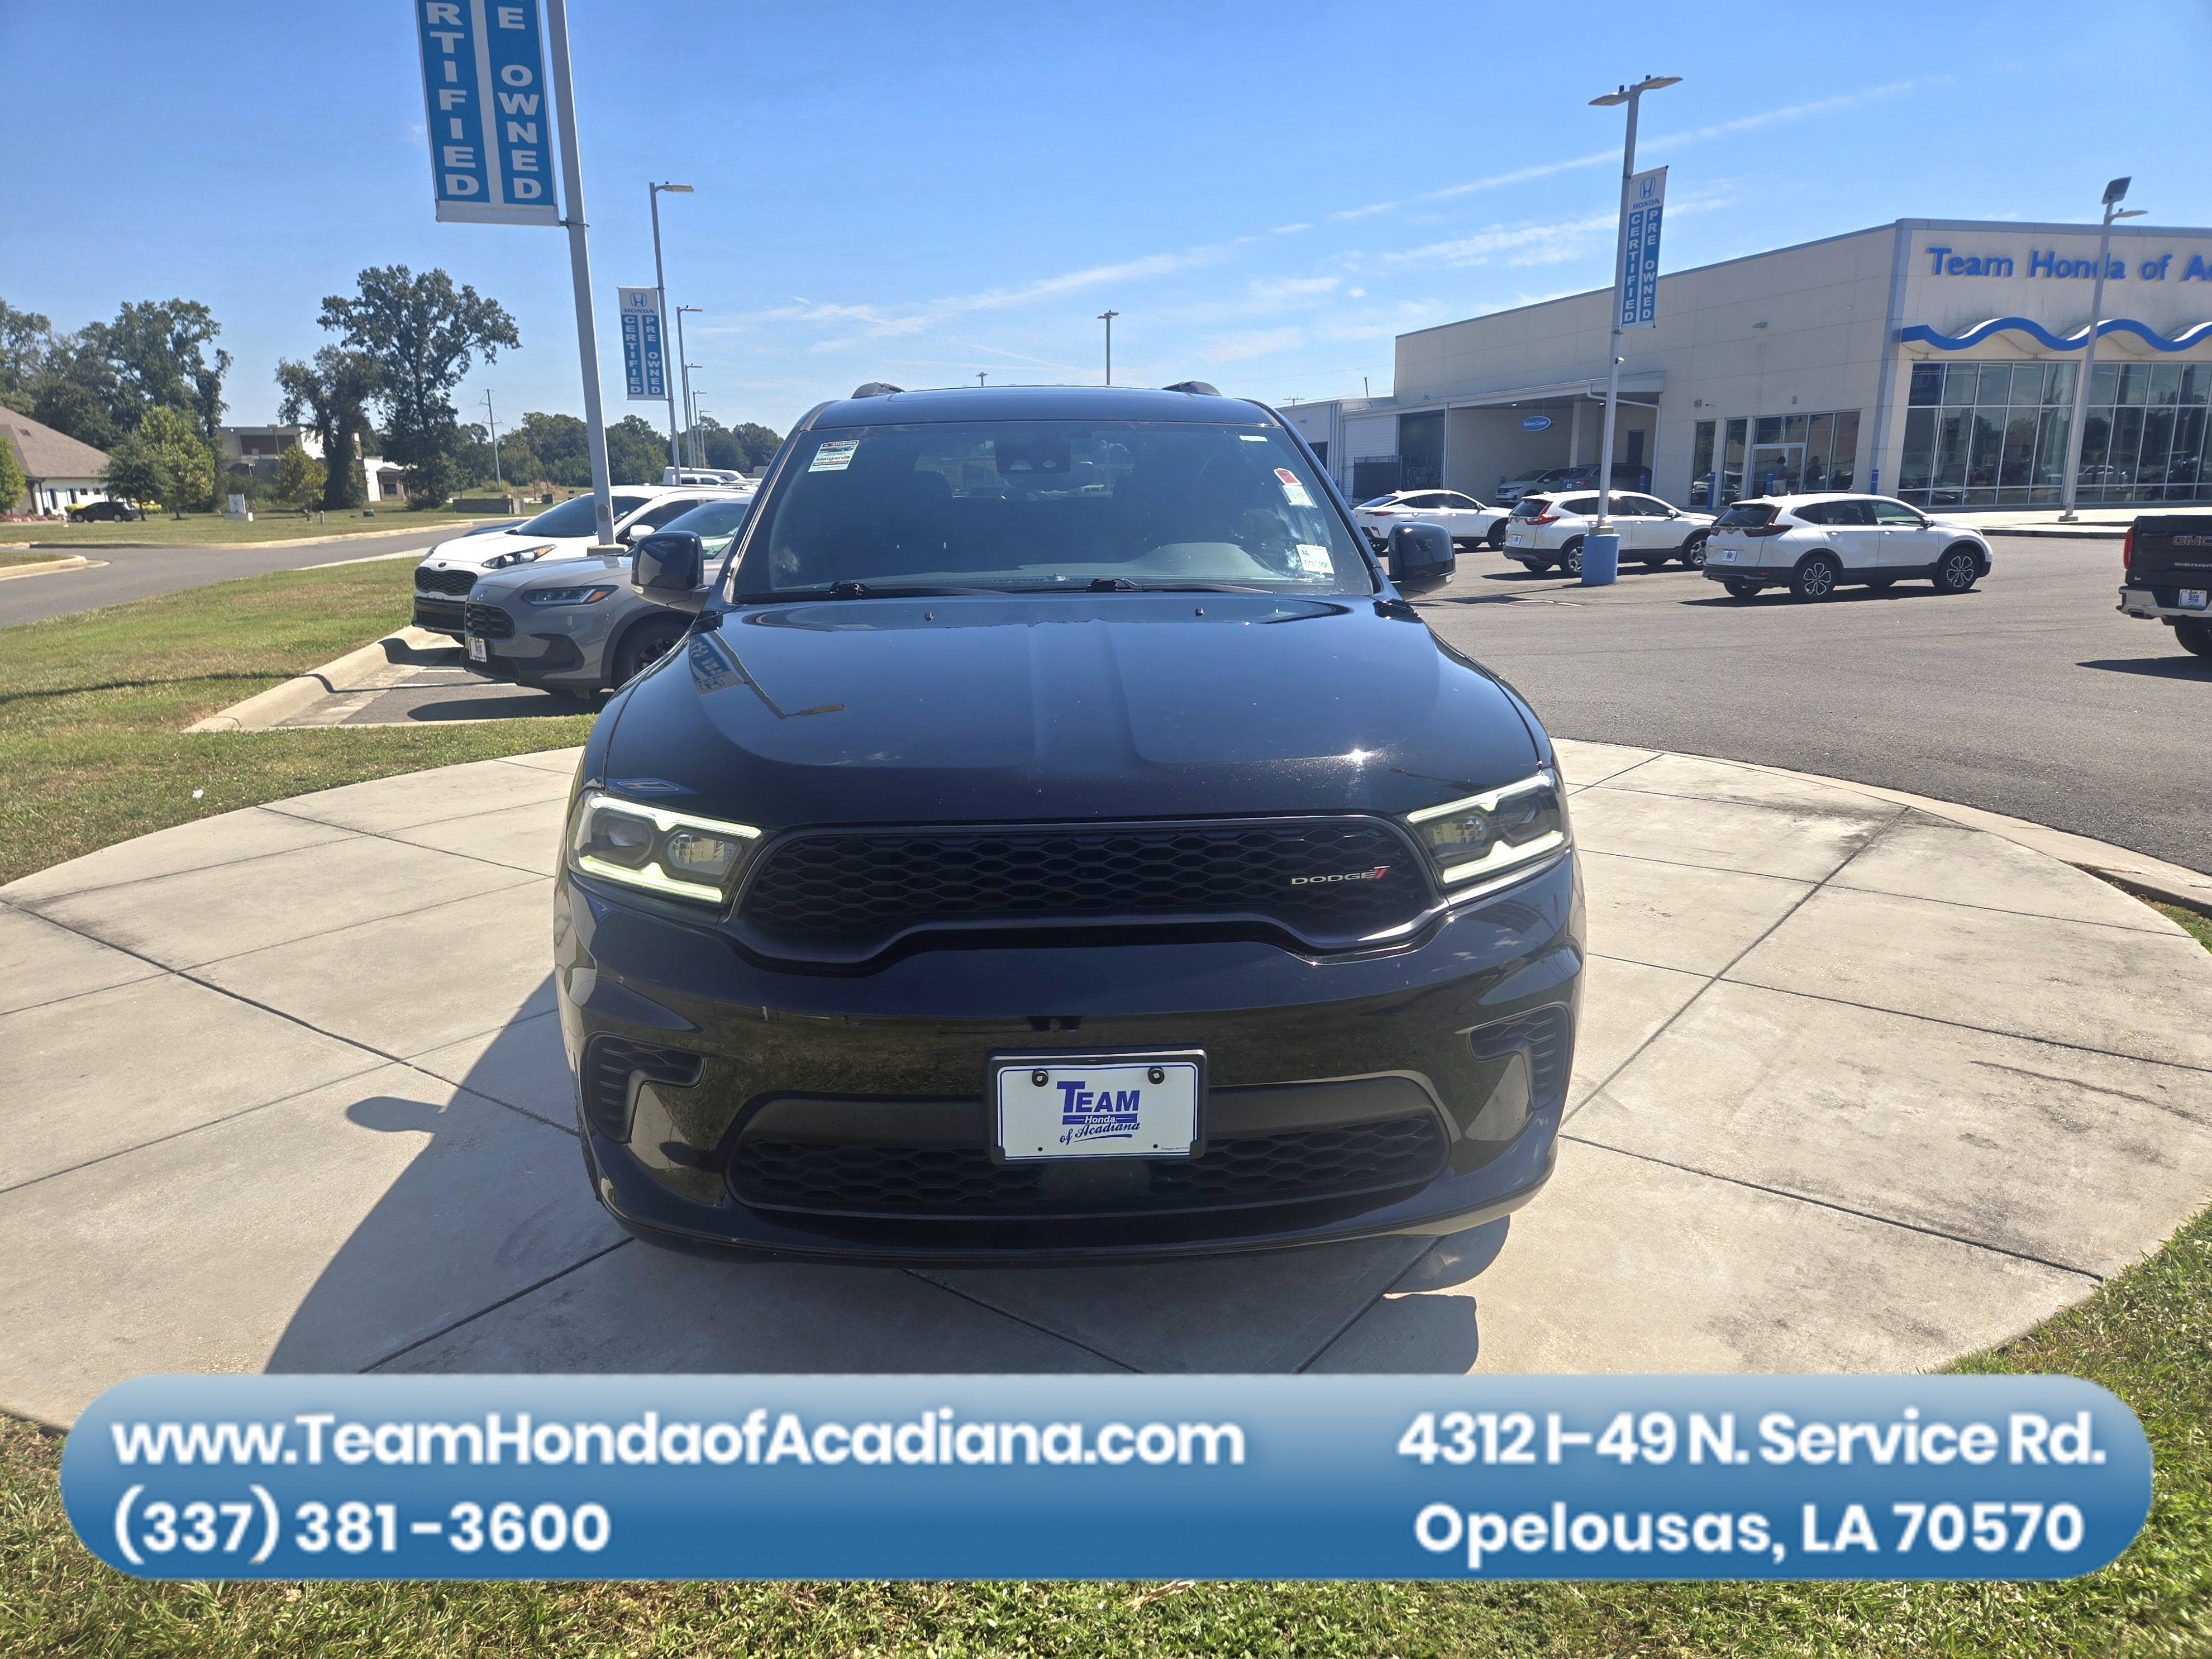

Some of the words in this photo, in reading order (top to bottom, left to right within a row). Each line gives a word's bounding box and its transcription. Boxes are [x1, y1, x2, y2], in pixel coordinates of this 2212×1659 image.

[498, 65, 542, 199] OWNED
[1632, 198, 1661, 210] HONDA
[1647, 209, 1658, 245] PRE
[1624, 214, 1641, 322] CERTIFIED
[1928, 247, 2014, 277] Team
[2029, 251, 2126, 279] Honda
[2140, 254, 2173, 280] of
[1642, 260, 1656, 320] OWNED
[646, 317, 656, 342] PRE
[624, 316, 642, 393] CERTIFIED
[647, 351, 661, 393] OWNED
[2173, 536, 2212, 546] GMC
[1291, 869, 1376, 885] DODGE
[1056, 1081, 1141, 1113] TEAM
[1060, 1128, 1073, 1145] of
[1075, 1121, 1141, 1138] Acadiana
[1085, 1115, 1116, 1124] Honda
